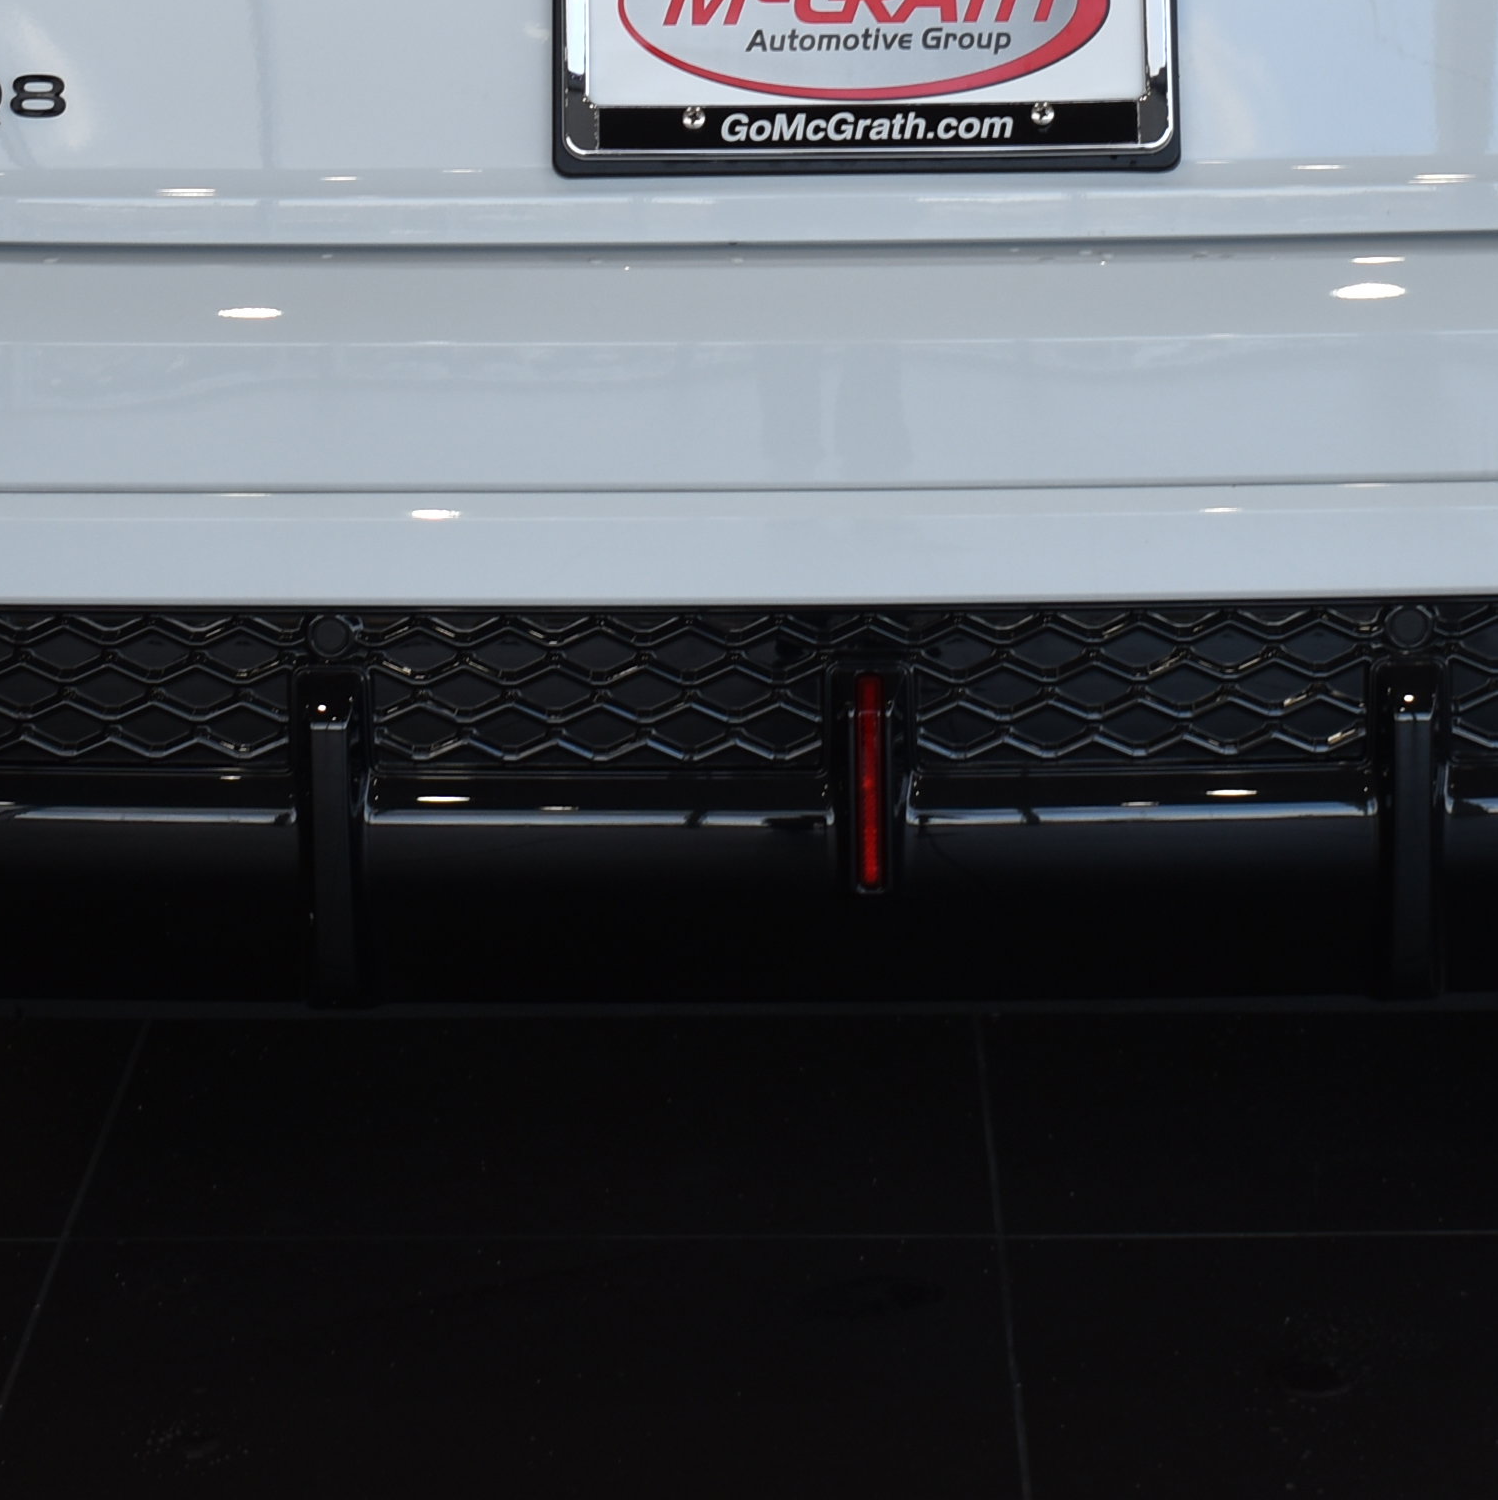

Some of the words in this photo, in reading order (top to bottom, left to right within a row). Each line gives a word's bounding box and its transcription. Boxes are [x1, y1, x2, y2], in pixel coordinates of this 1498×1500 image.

[746, 28, 912, 53] Automotive
[922, 28, 1012, 54] Group
[720, 111, 1014, 142] GoMcGrath.com
